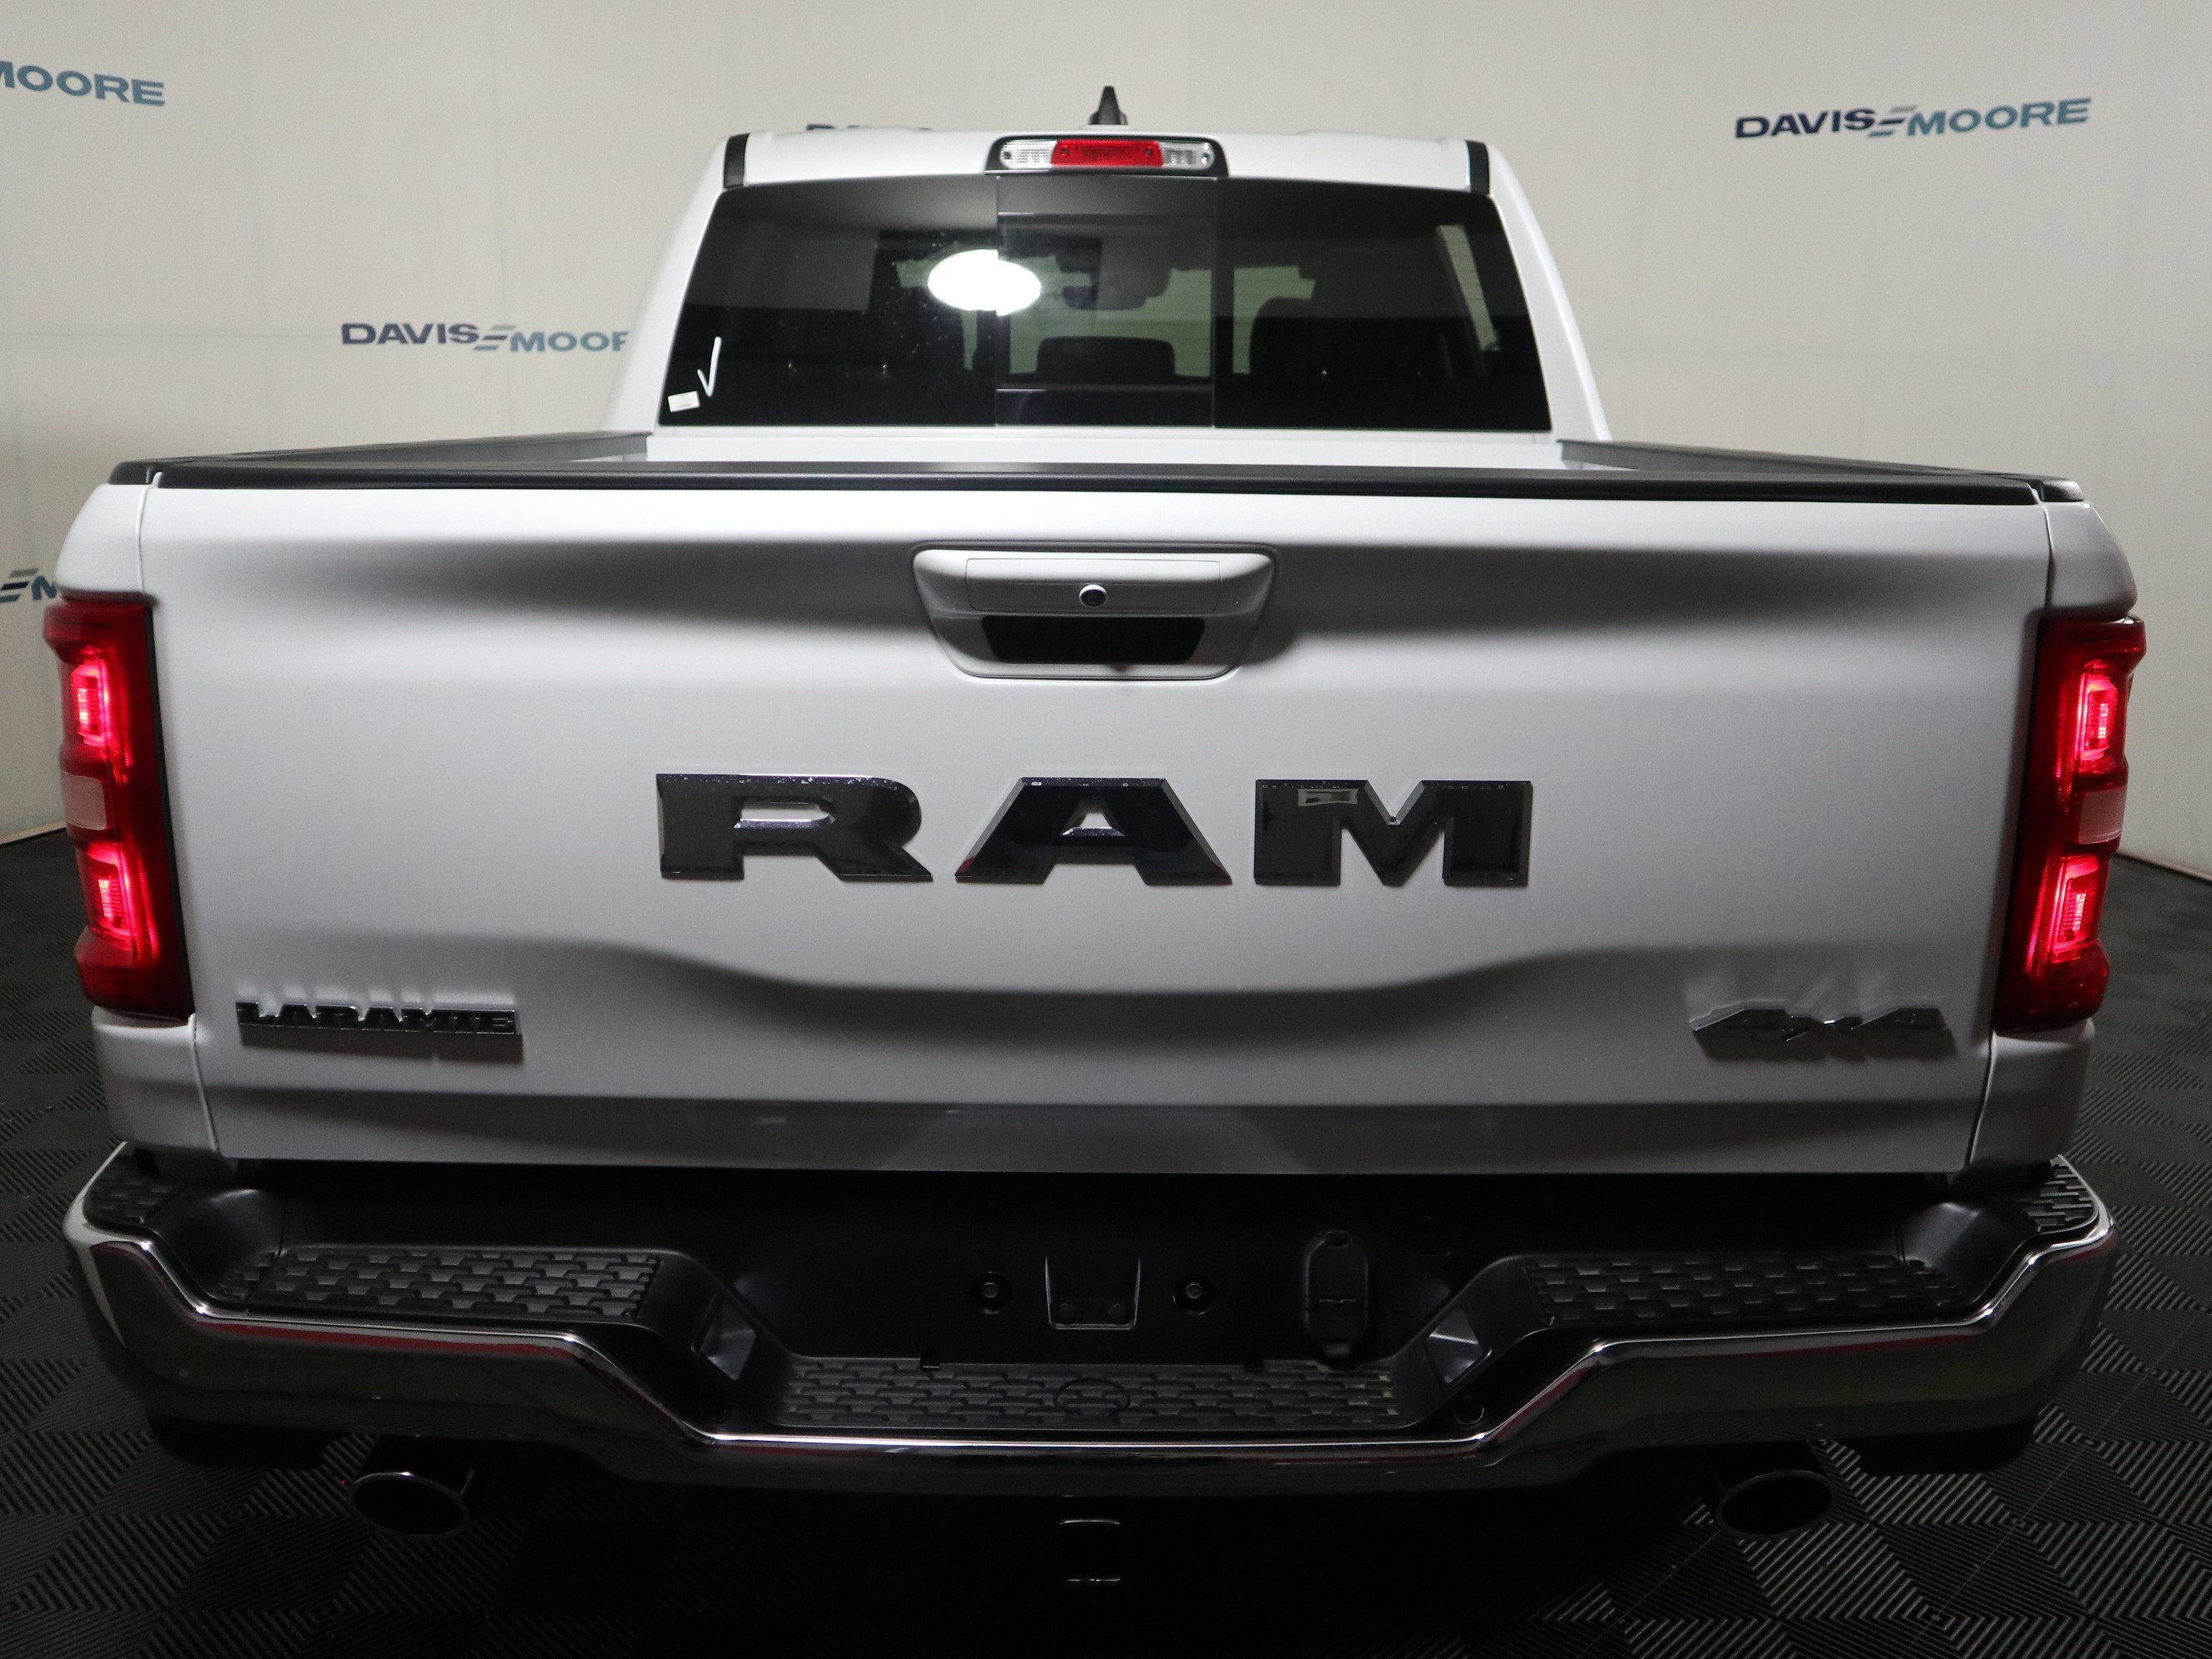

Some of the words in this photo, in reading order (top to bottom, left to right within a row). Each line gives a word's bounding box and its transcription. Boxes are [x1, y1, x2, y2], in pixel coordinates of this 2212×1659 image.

[1735, 107, 1876, 138] DAVIS
[1906, 97, 2092, 137] MOORE
[341, 322, 481, 346] DAVIS
[510, 331, 629, 352] MOOR
[656, 772, 1532, 888] RAM
[235, 1000, 522, 1041] LARAMIE
